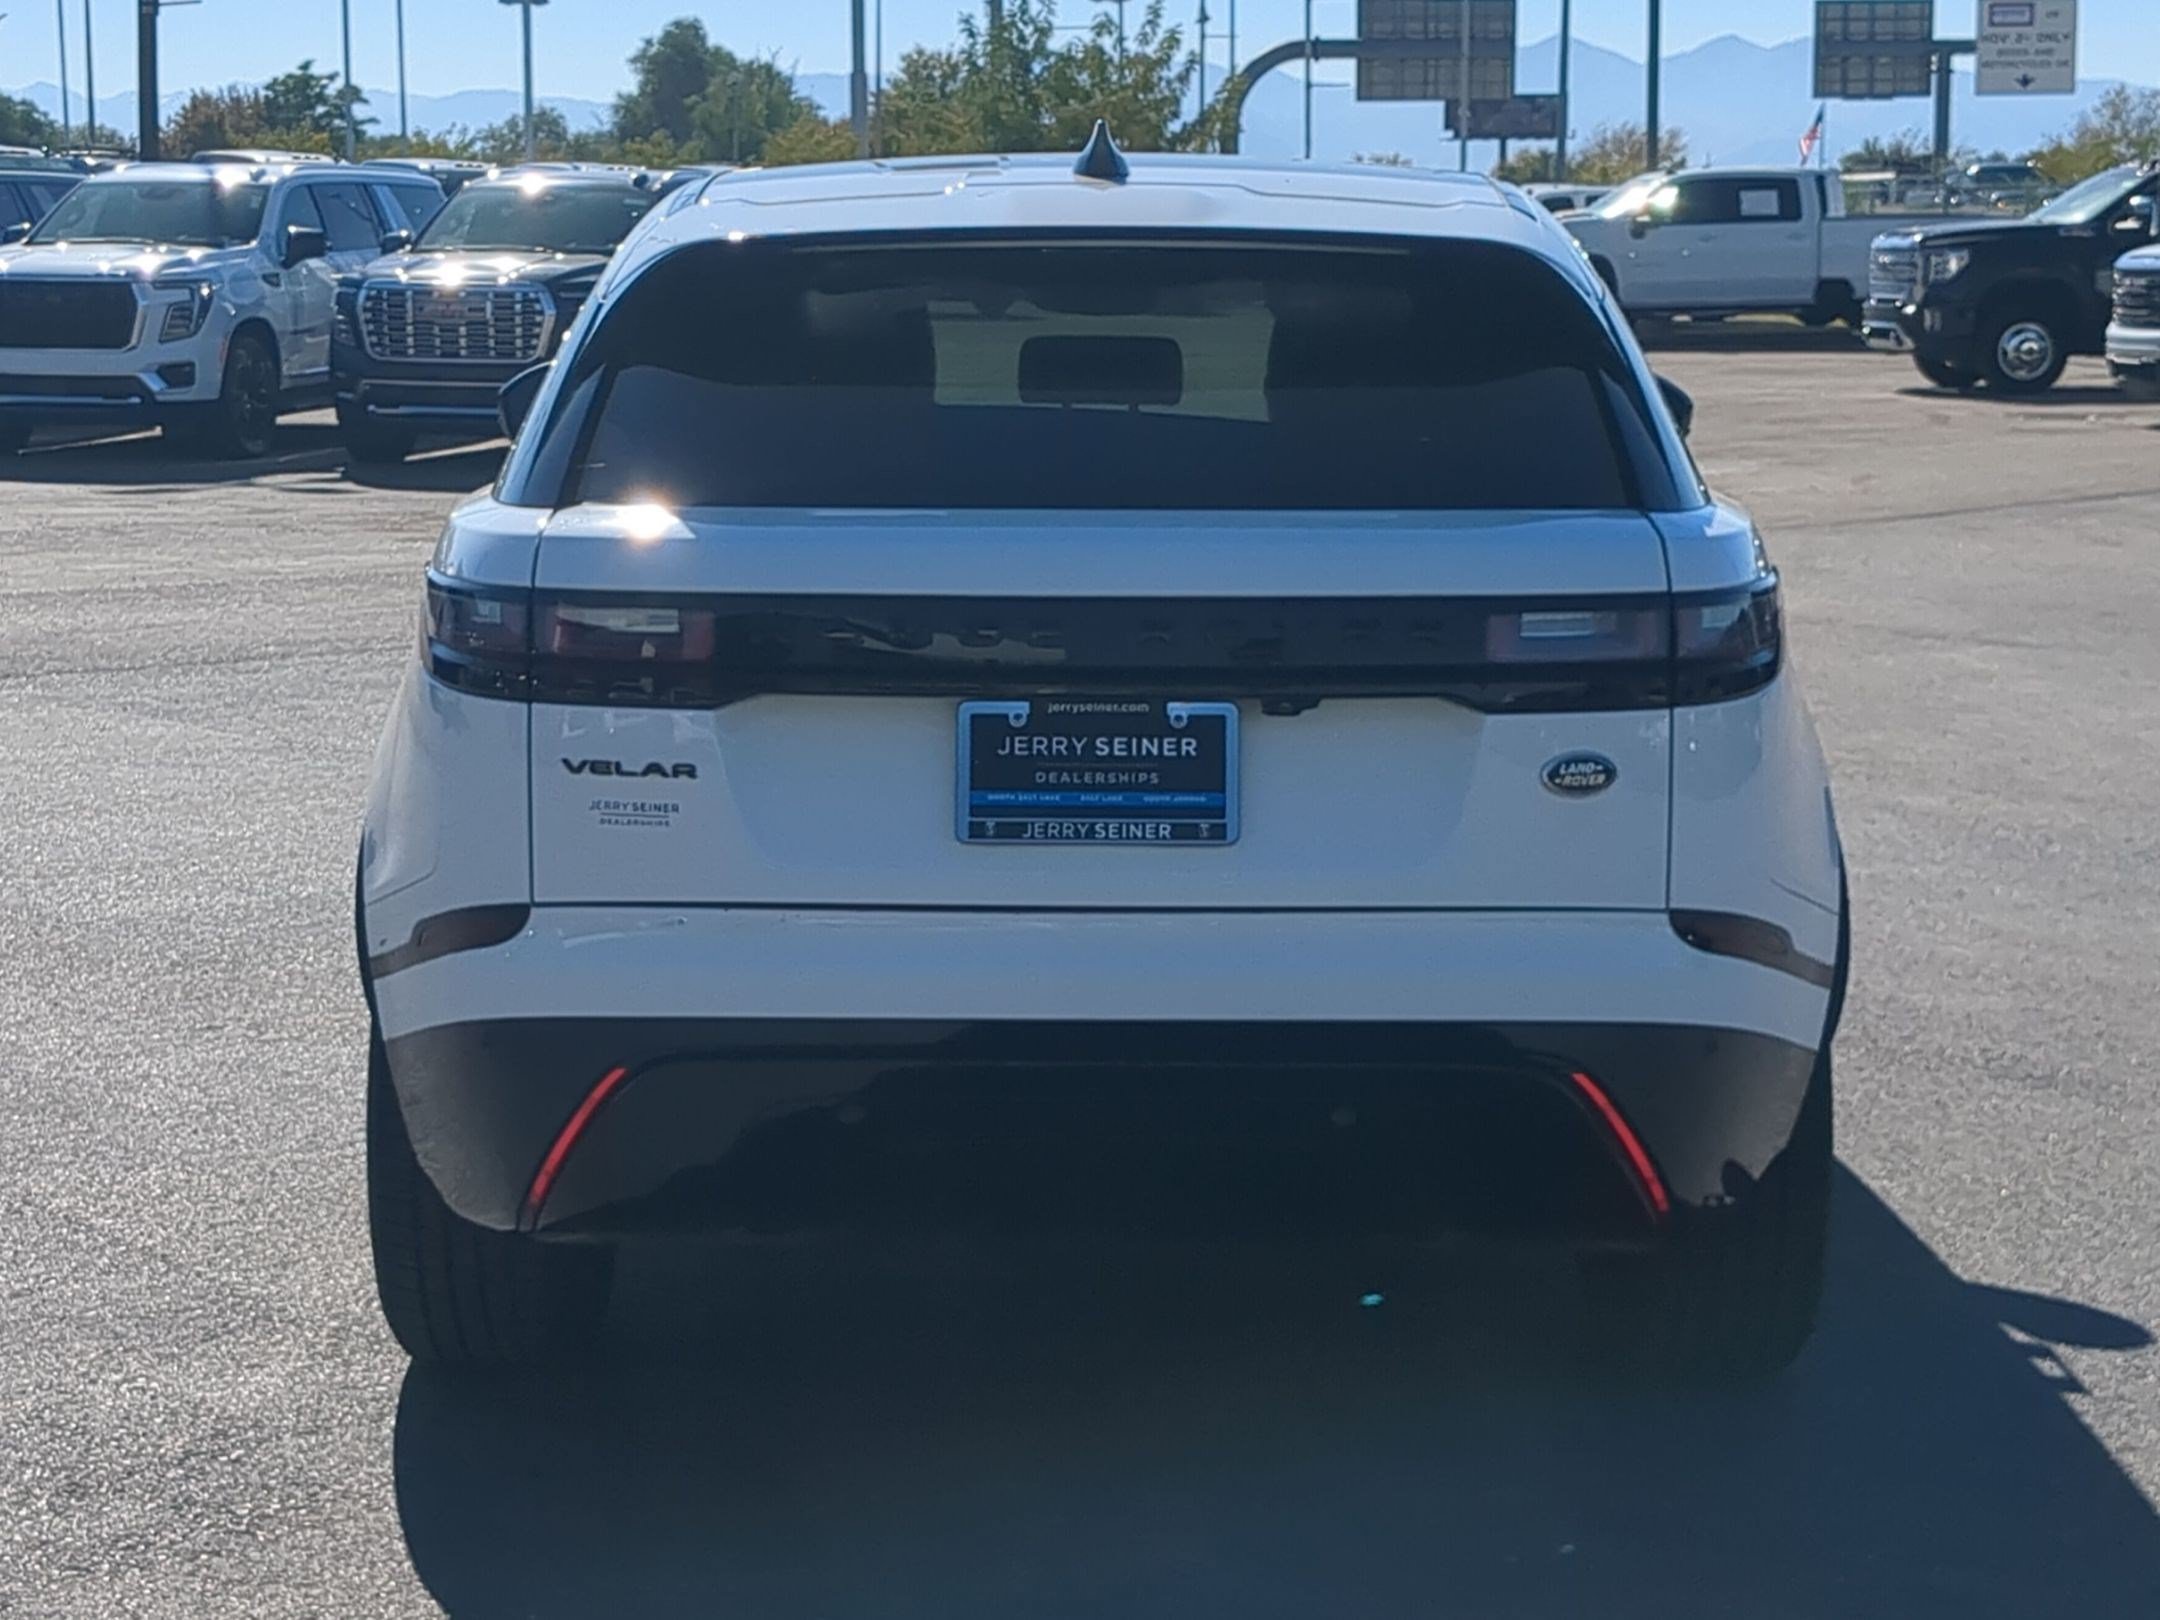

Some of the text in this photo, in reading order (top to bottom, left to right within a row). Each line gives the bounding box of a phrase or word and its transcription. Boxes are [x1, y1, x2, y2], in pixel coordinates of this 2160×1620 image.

[1047, 702, 1150, 714] jerryseiner.com
[997, 736, 1198, 757] JERRY SEINER
[561, 758, 697, 779] VELAR
[1035, 771, 1160, 785] DEALERSHIPS
[589, 800, 680, 814] JERRY SEINER
[599, 817, 670, 827] DEALERSHIPS
[1022, 823, 1172, 839] JERRY SEINER
